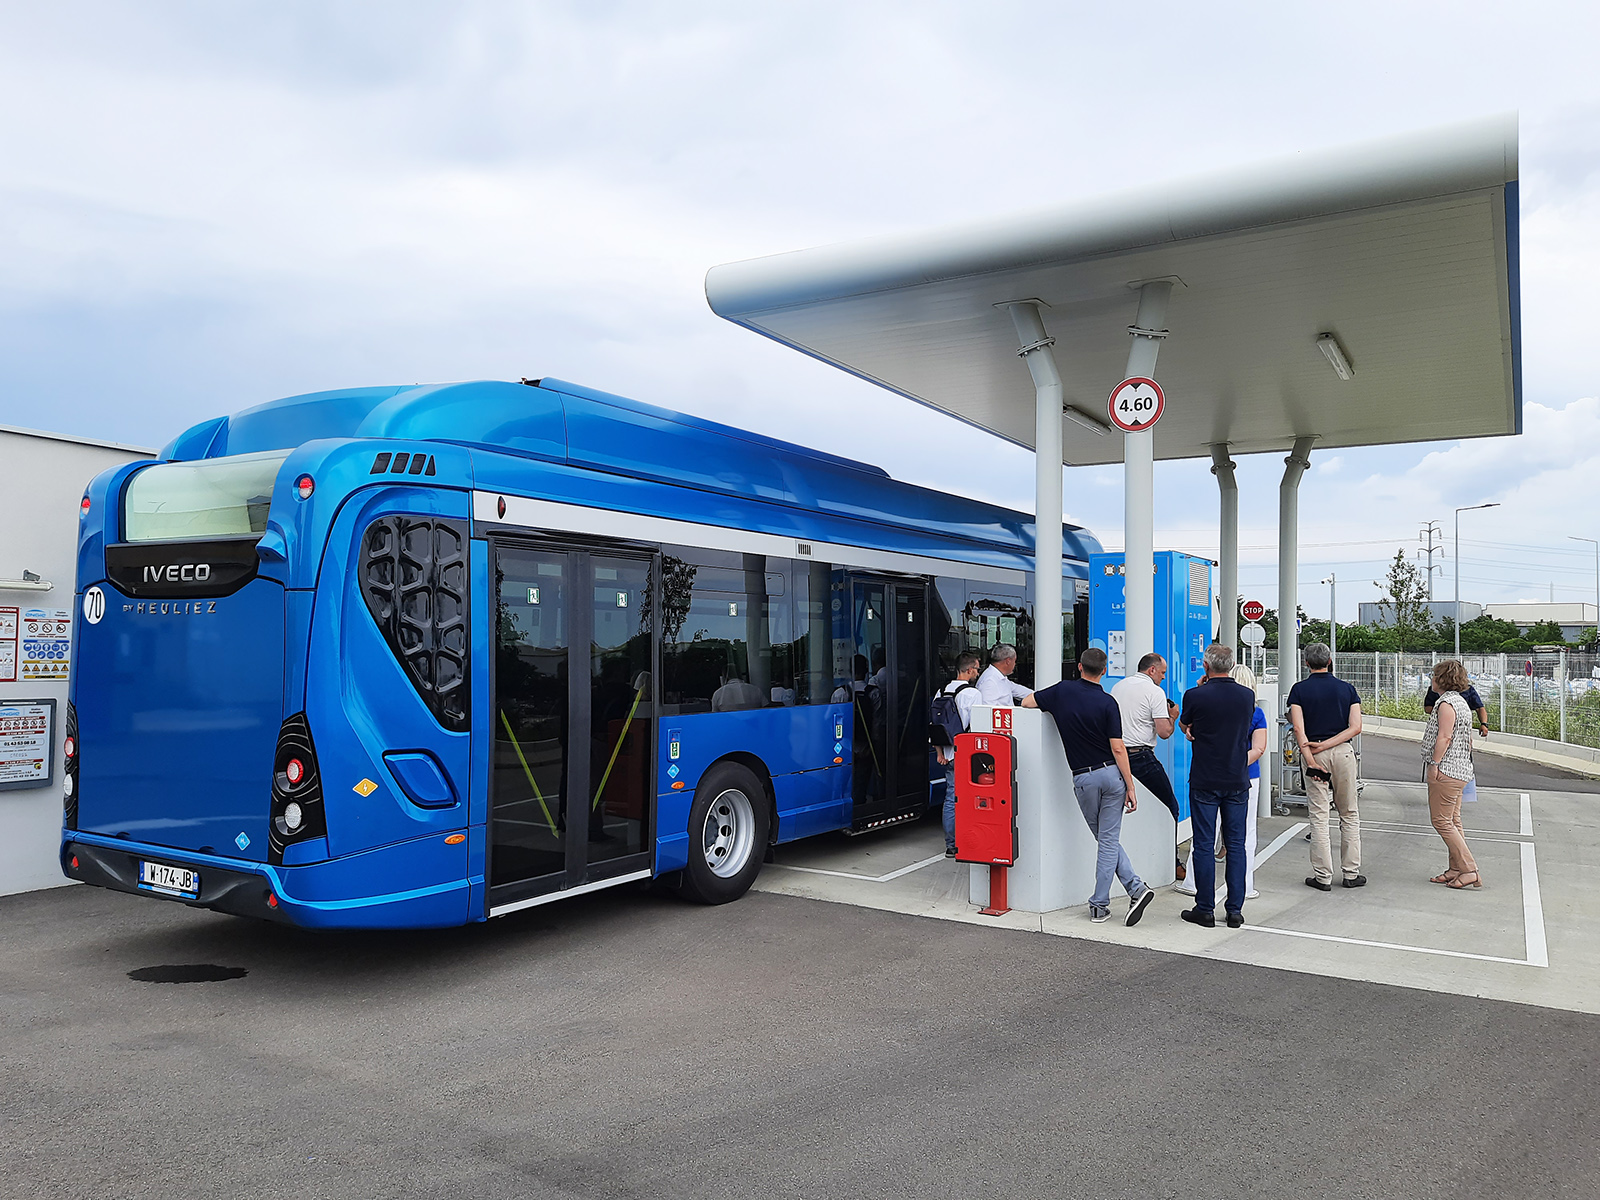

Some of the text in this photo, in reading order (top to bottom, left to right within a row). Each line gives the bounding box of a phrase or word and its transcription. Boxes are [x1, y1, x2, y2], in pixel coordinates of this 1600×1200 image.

[1119, 397, 1153, 412] 4.60
[143, 563, 210, 583] IVECO
[88, 591, 102, 619] 70
[122, 601, 216, 615] BY HEULIEZ
